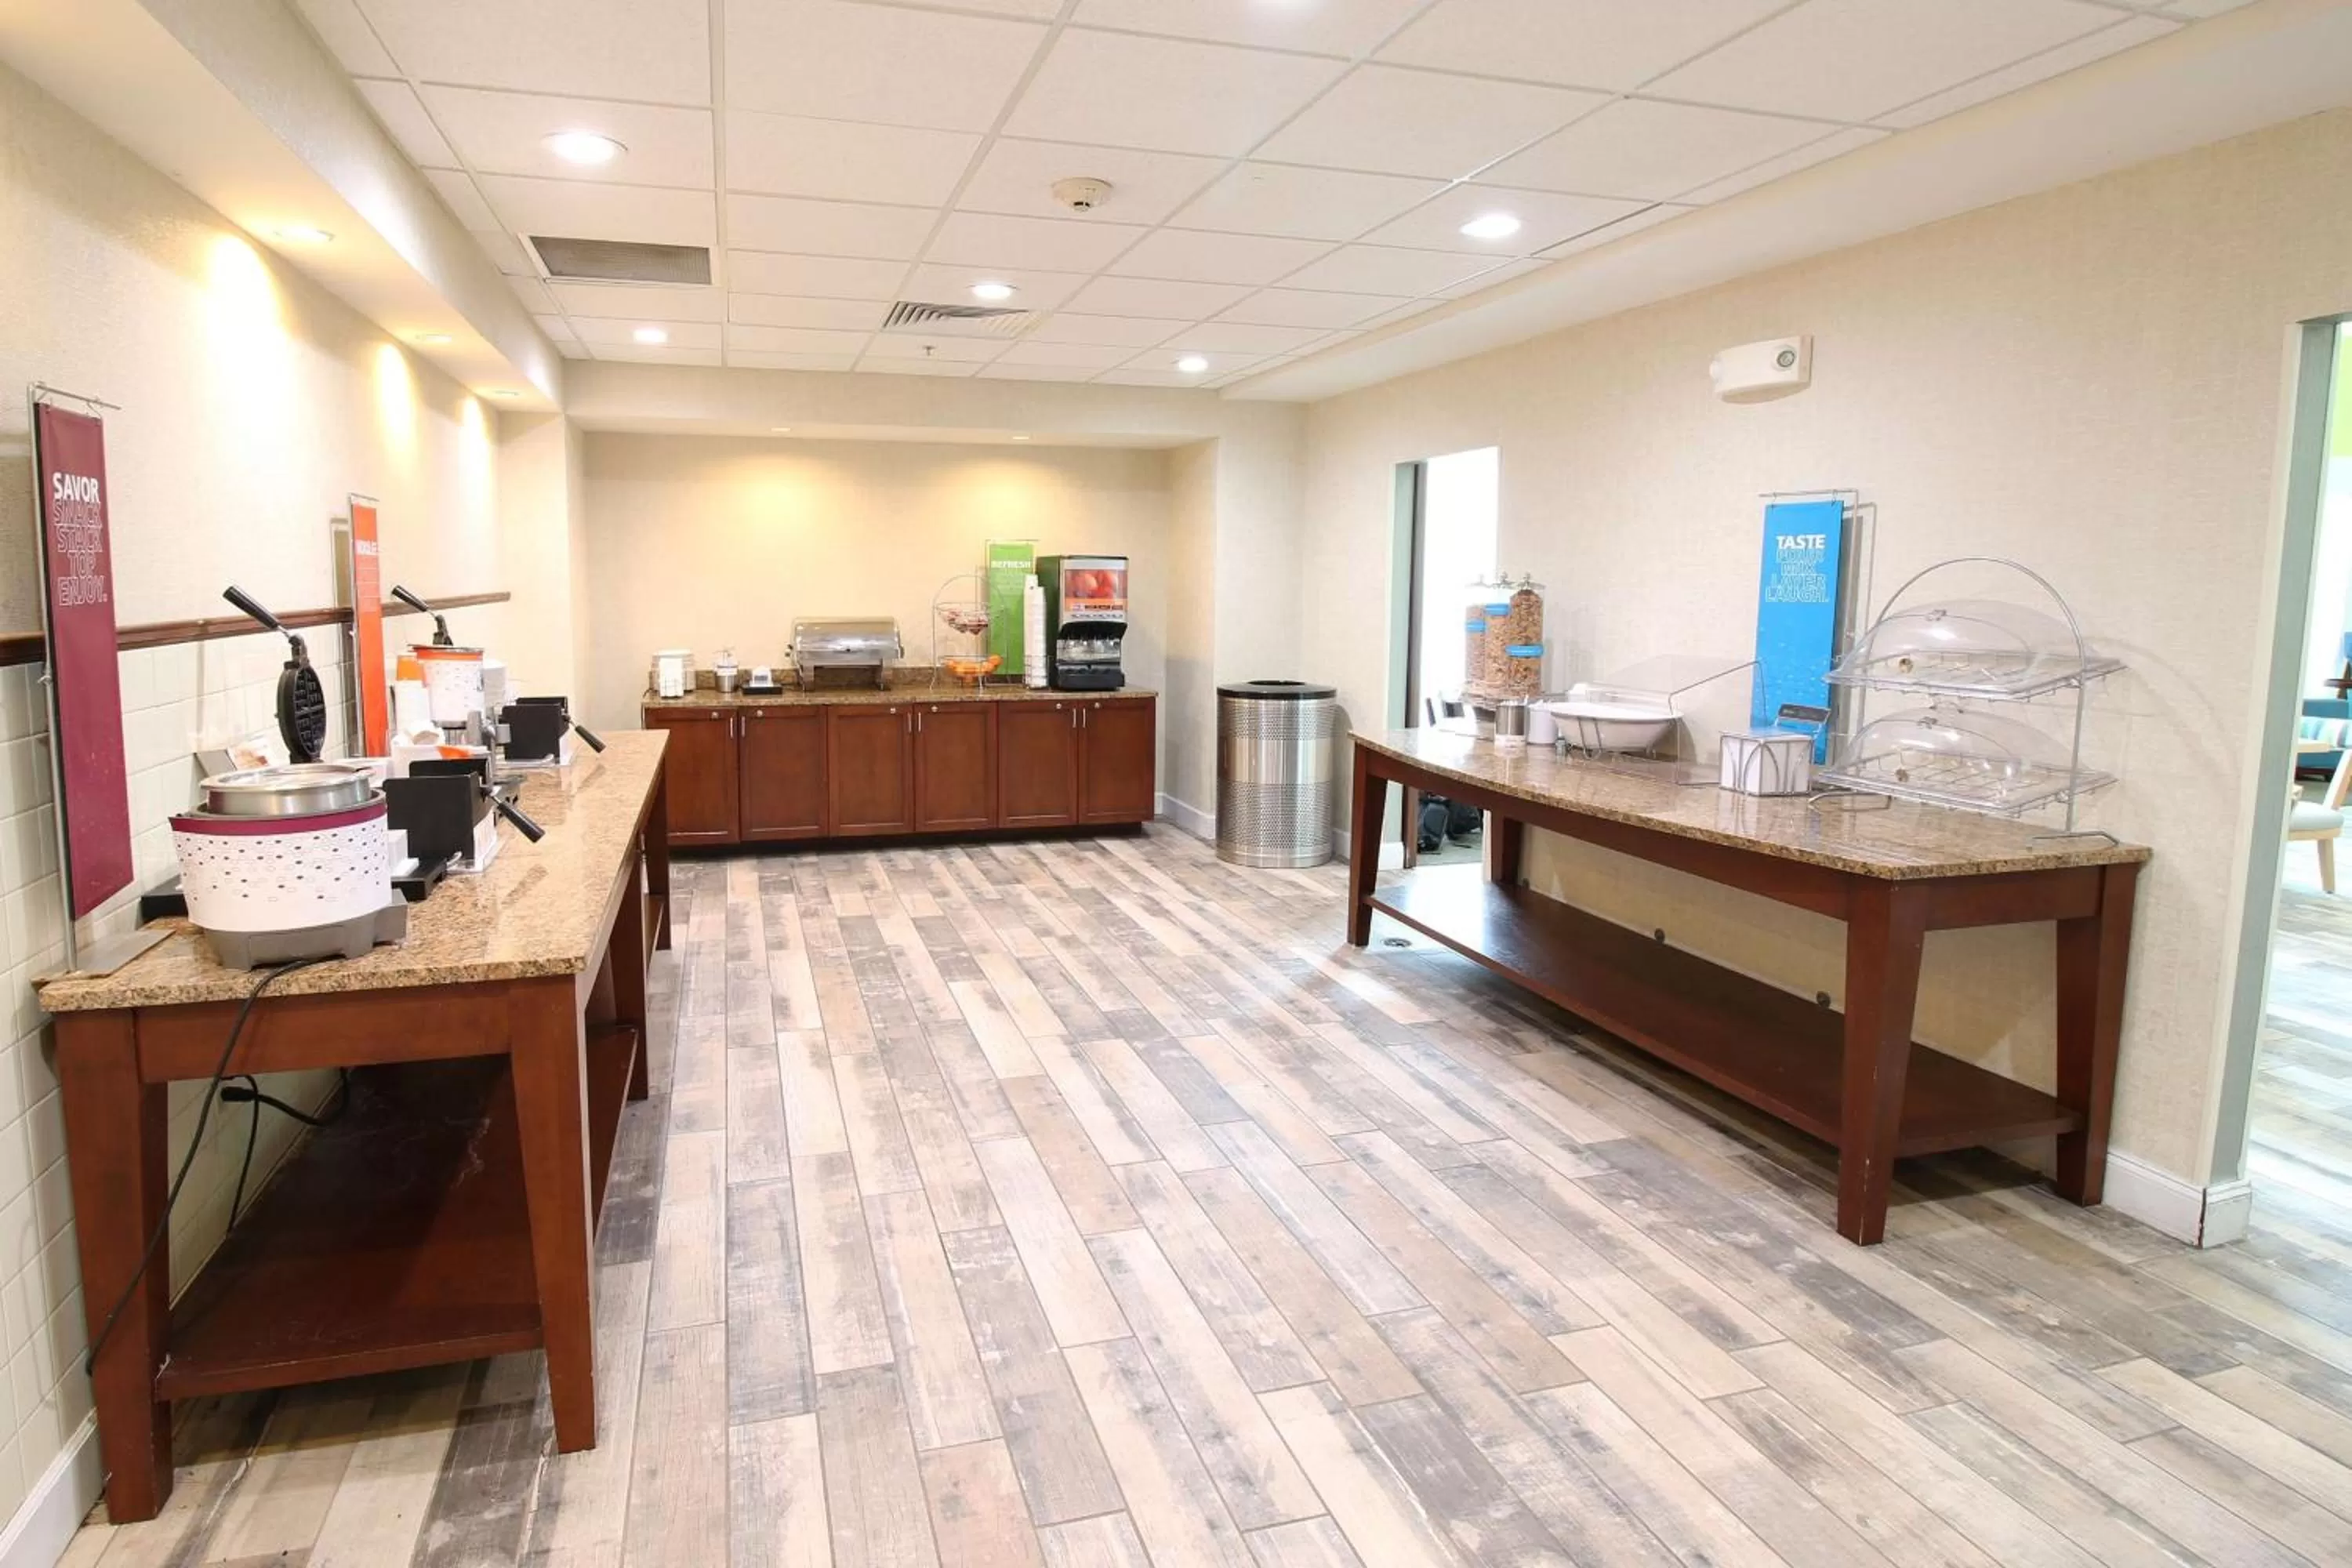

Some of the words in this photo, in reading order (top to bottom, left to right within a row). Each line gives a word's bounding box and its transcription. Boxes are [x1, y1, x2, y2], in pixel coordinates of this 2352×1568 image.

[52, 472, 100, 503] SAVOR
[1775, 534, 1826, 550] TASTE
[67, 549, 96, 578] TOP
